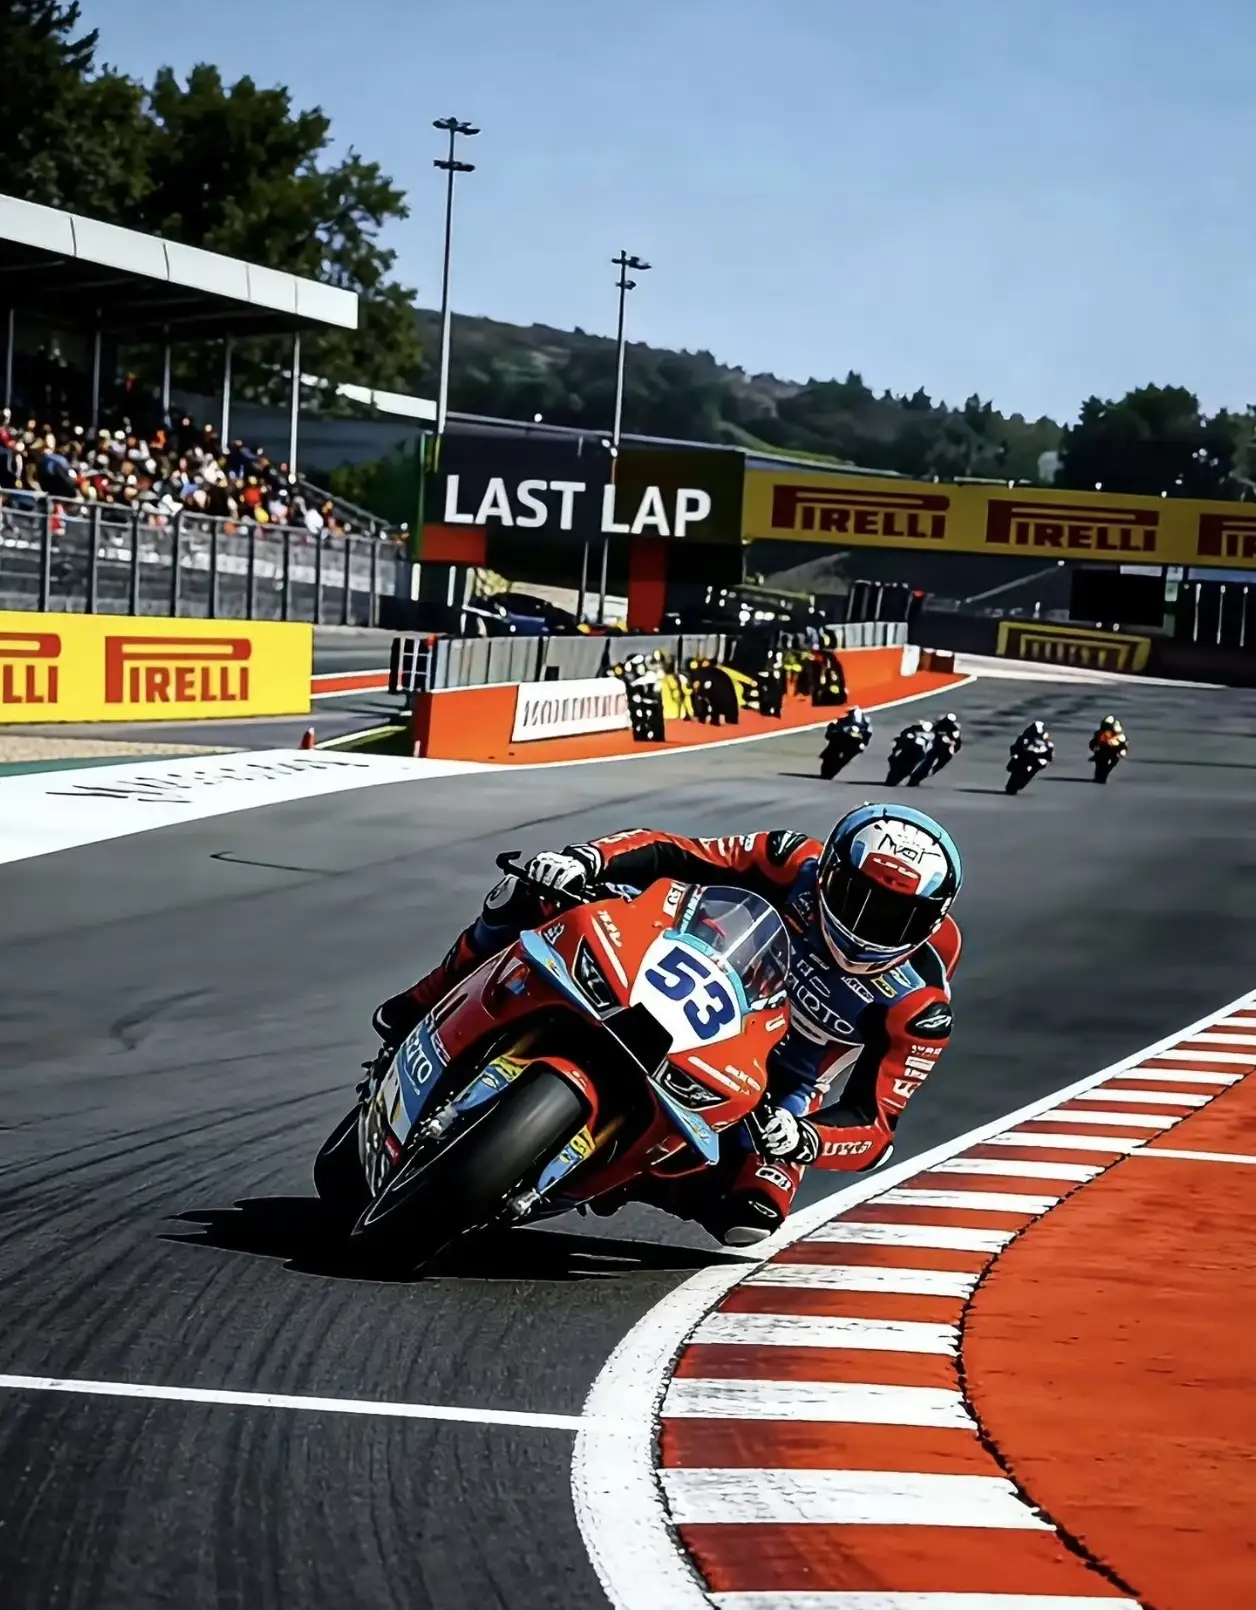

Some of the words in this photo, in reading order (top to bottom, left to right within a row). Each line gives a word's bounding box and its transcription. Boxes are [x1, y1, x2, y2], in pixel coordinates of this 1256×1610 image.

[444, 474, 585, 530] LAST
[600, 484, 712, 538] LAP
[771, 484, 951, 539] PIRELLI
[986, 499, 1159, 552] PIRELLI
[105, 636, 252, 703] PIRELLI
[645, 946, 735, 1040] 53
